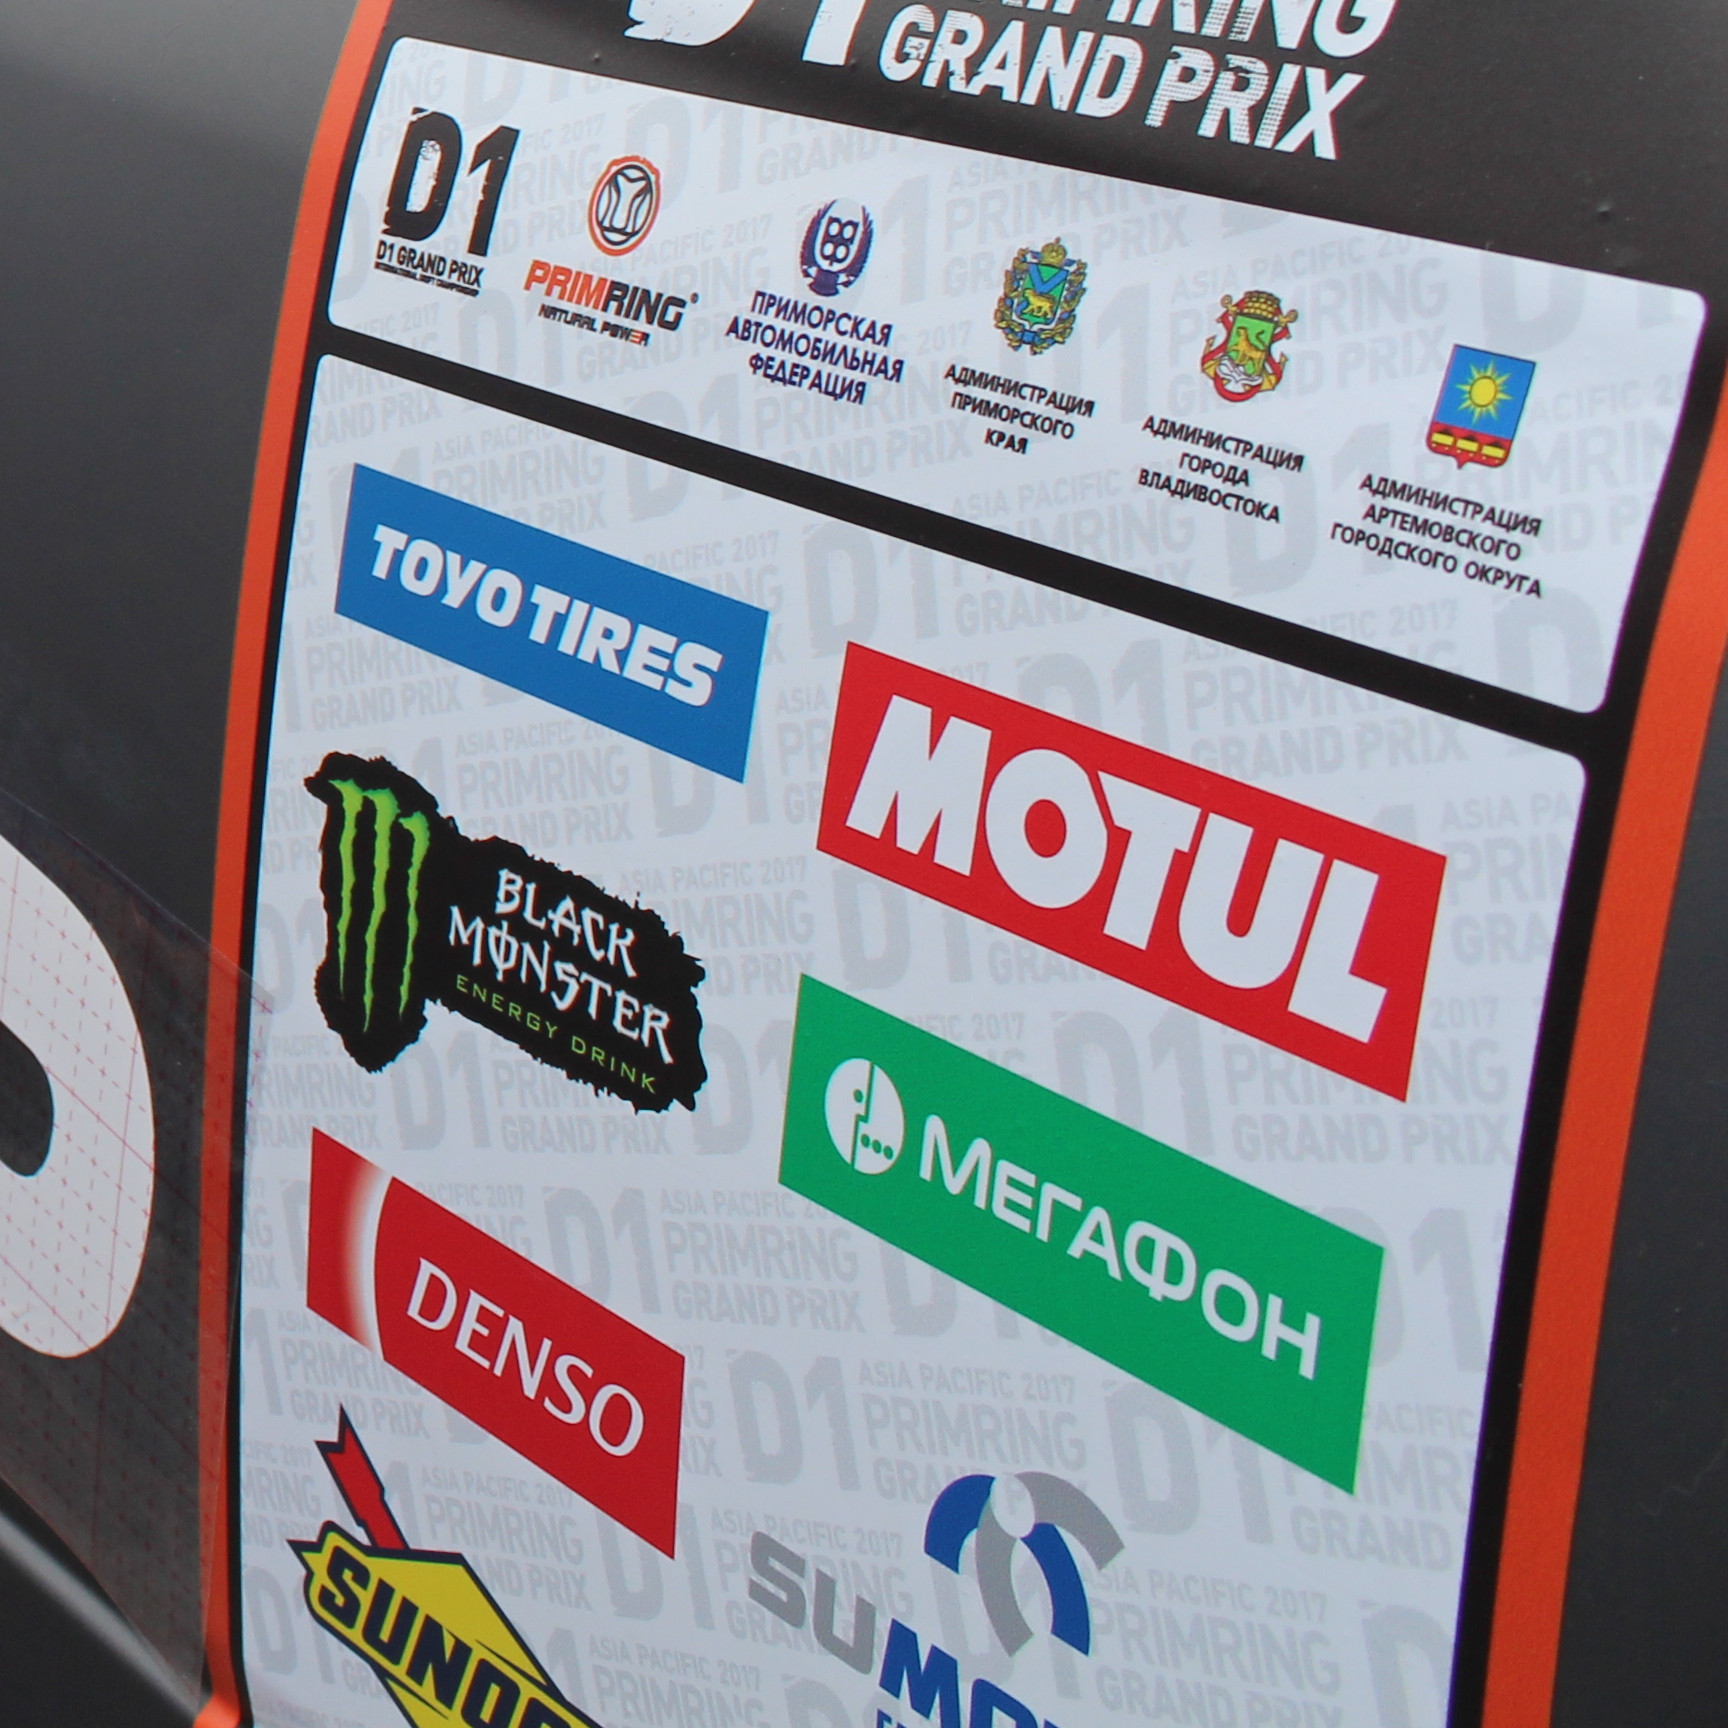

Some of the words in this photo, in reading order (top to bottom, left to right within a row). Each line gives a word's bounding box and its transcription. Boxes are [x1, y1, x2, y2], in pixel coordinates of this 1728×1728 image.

[880, 4, 1143, 119] GRAND
[1145, 45, 1365, 161] PRIX
[381, 107, 522, 257] D1
[376, 239, 395, 262] D1
[396, 246, 447, 276] GRAND
[448, 259, 485, 288] PRIX
[538, 303, 597, 333] NATURAL
[750, 290, 893, 348] ПРИМОРСКАЯ
[725, 315, 905, 383] АВТОМОБИЛЬНАЯ
[749, 352, 868, 405] ФЕДЕРАЦИЯ
[944, 364, 1095, 418] АДМИНИСТРАЦИЯ
[951, 392, 1075, 440] ПРИМОРСКОГО
[984, 428, 1029, 455] КРАЯ
[1142, 415, 1305, 472] АДМИНИСТРАЦИЯ
[1179, 452, 1250, 488] ГОРОДА
[1138, 468, 1280, 524] ВЛАДИВОСТОКА
[1360, 474, 1542, 537] АДМИНИСТРАЦИЯ
[1331, 522, 1458, 573] ГОРОДСКОГО
[1464, 560, 1542, 599] ОКРУГА
[1363, 504, 1521, 562] АРТЕМОВСКОГО
[371, 523, 523, 628] TOYO
[527, 584, 724, 709] TIRES
[846, 693, 1389, 1045] MOTUL
[495, 868, 638, 978] BLACK
[456, 974, 559, 1039] ENERGY
[571, 1035, 656, 1095] DRINK
[919, 1114, 1322, 1381] МЕГАФОН
[405, 1256, 645, 1457] DENSO
